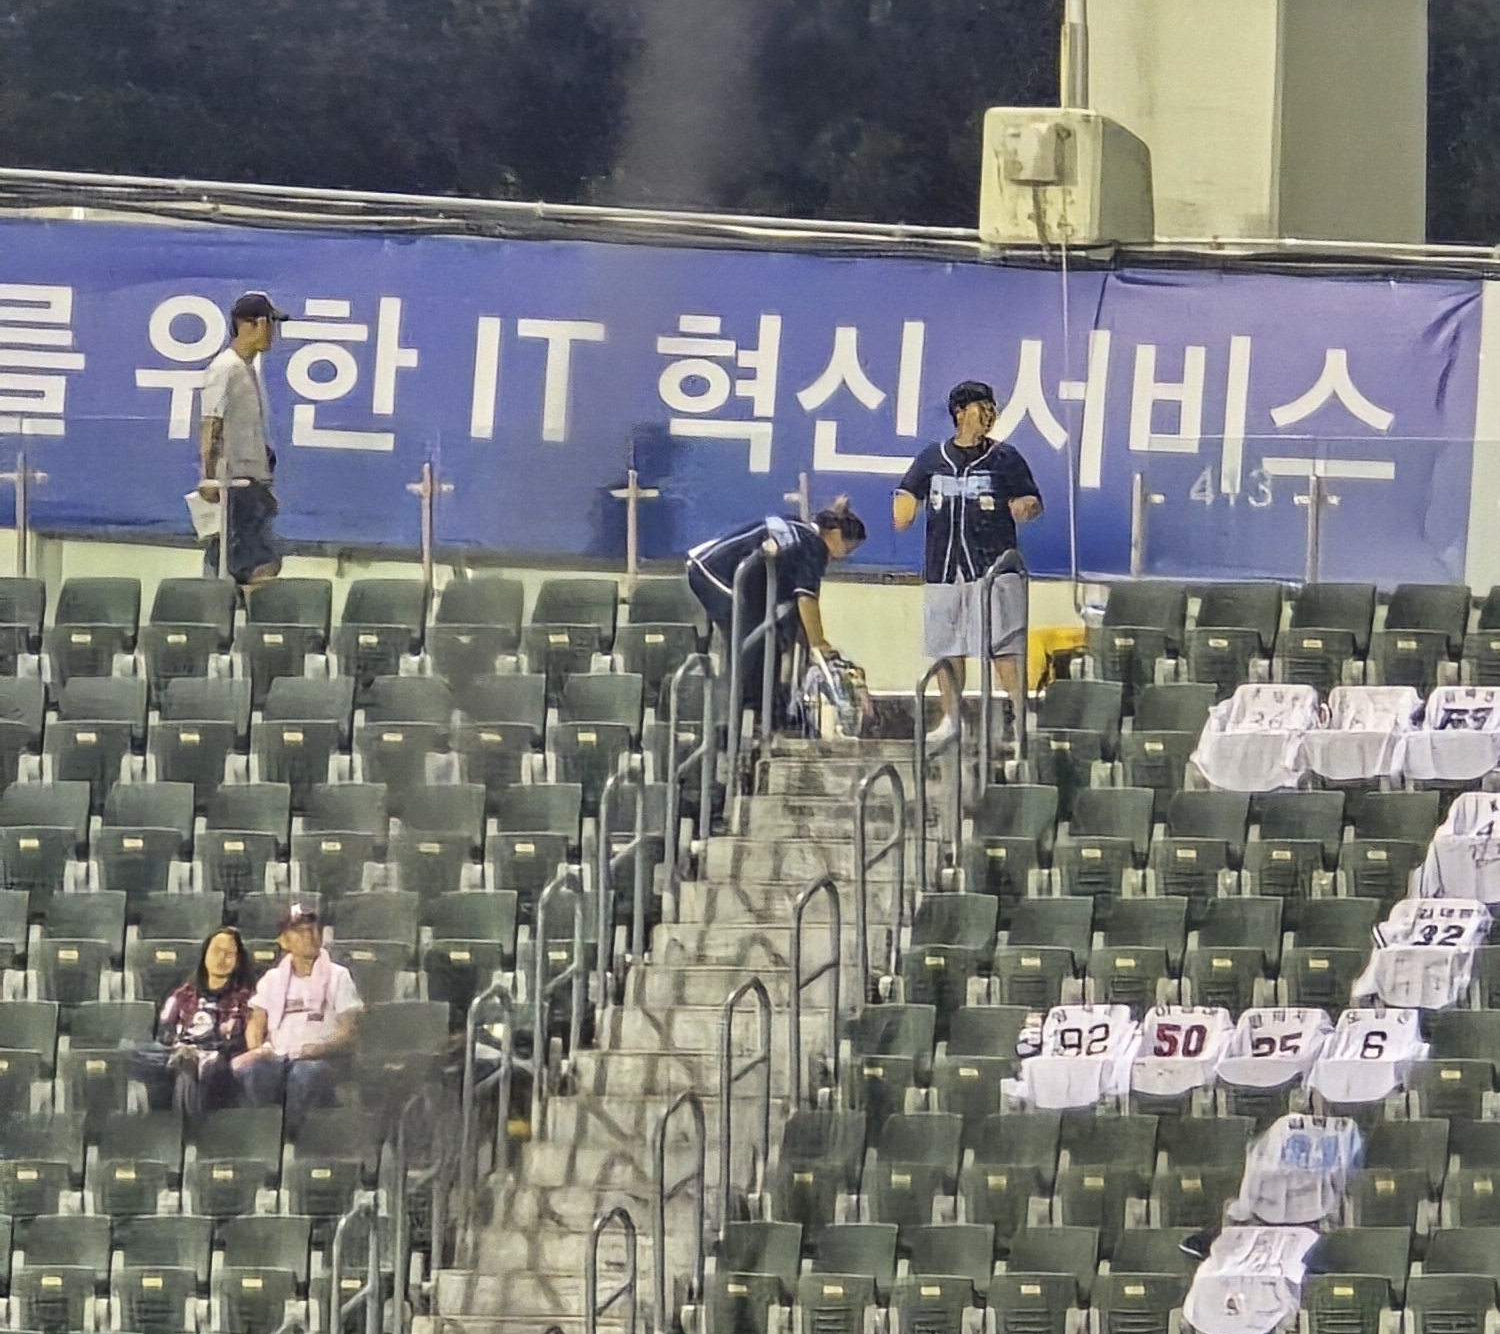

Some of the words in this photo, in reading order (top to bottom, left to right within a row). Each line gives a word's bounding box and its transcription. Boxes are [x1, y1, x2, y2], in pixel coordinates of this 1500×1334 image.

[0, 285, 86, 436] 를
[134, 294, 419, 451] 위한
[470, 316, 606, 443] IT
[657, 314, 927, 474] 혁신
[988, 329, 1397, 494] 서비스
[1153, 1023, 1208, 1057] 50
[1360, 1031, 1387, 1059] 6
